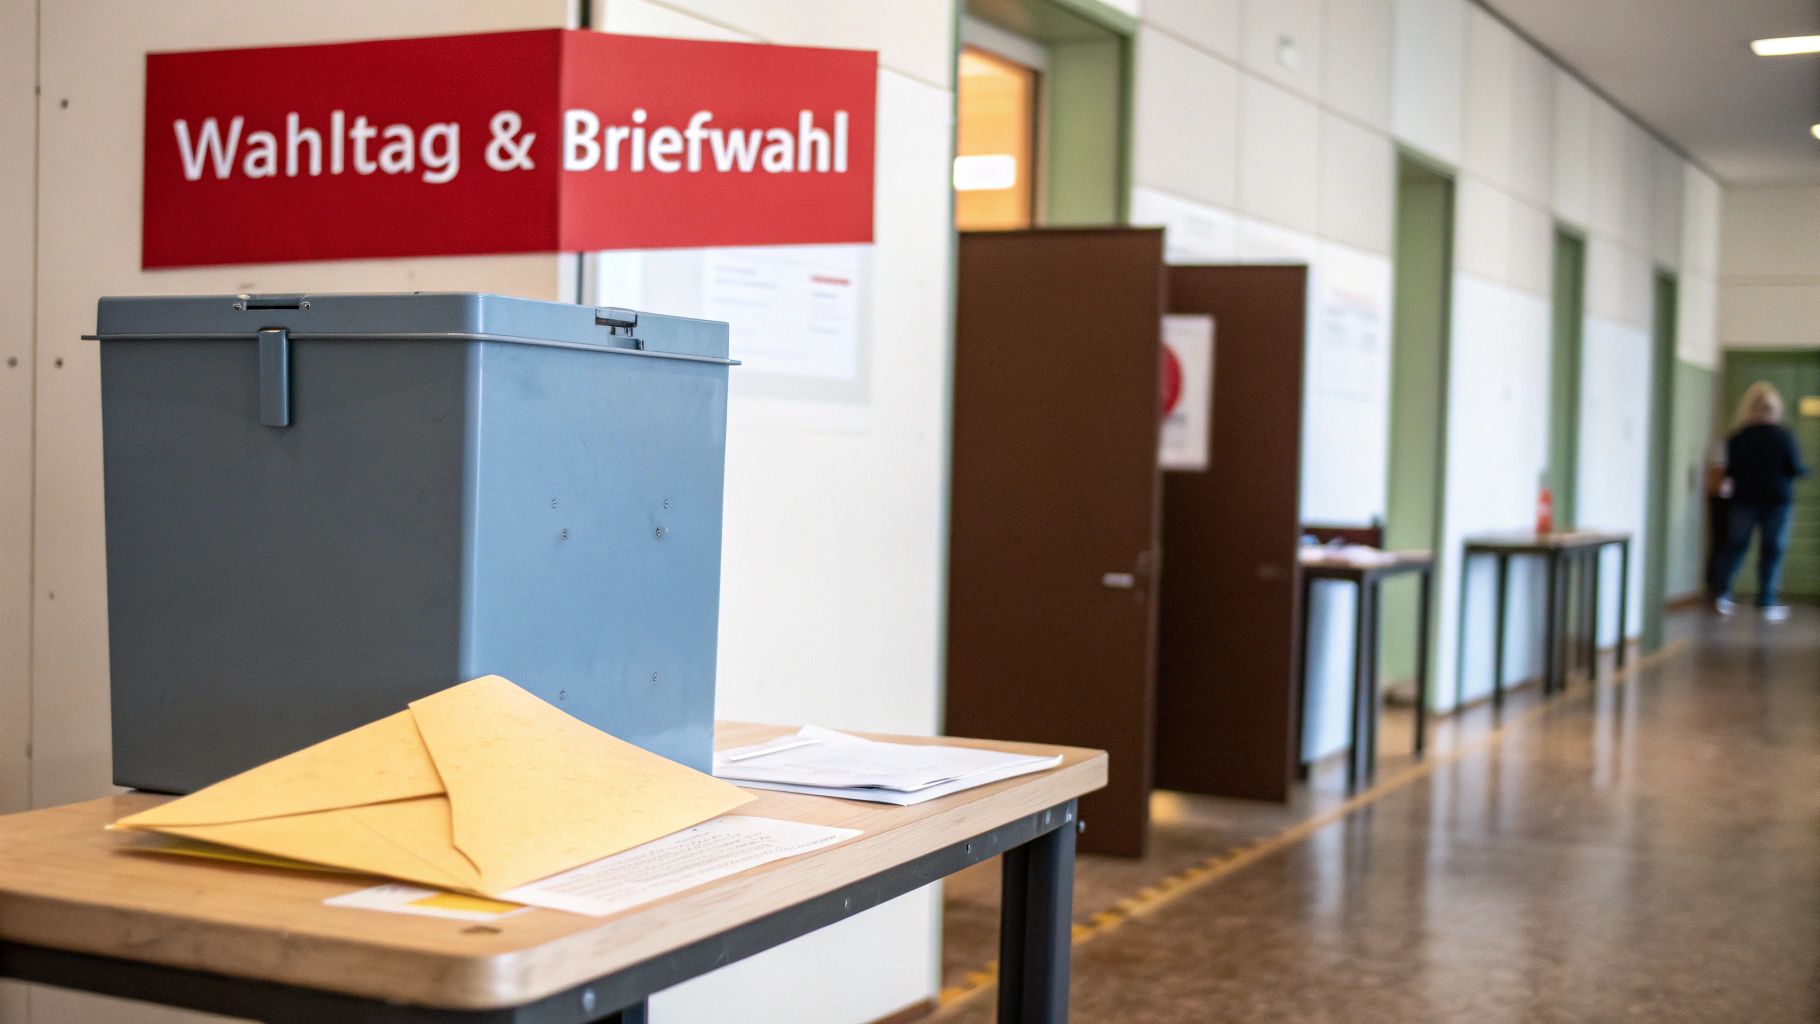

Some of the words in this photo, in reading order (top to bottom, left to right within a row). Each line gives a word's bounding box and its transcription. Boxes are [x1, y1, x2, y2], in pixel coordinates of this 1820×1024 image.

[173, 110, 461, 184] Wahltag
[484, 110, 536, 171] &
[562, 108, 850, 173] Briefwahl
